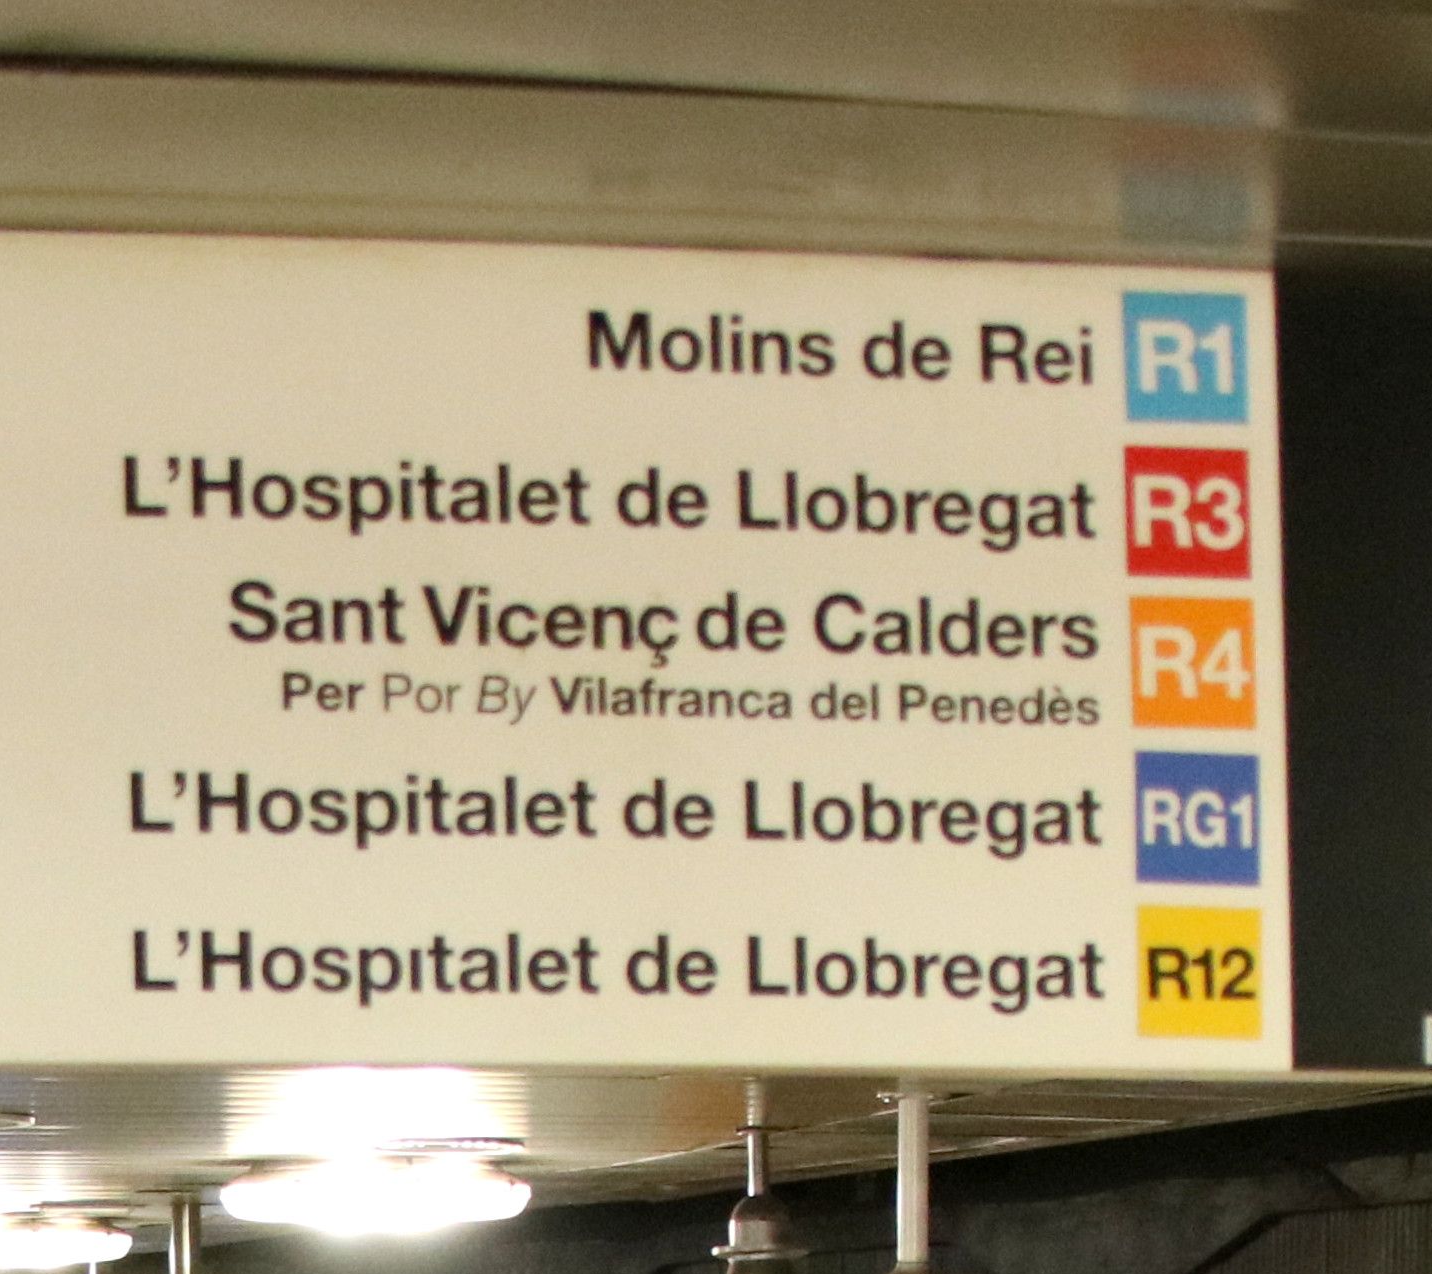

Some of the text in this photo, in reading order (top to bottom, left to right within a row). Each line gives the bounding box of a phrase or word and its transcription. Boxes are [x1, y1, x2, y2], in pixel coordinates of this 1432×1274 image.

[588, 311, 1093, 385] Molins de Rei
[1136, 319, 1236, 395] R1
[616, 466, 708, 530] de
[737, 470, 1097, 553] Llobregat
[1132, 473, 1246, 552] R3
[229, 580, 1100, 669] Sant Vicenç de Calders
[1137, 624, 1251, 700] R4
[281, 672, 1101, 727] Per Por By Vilafranca del Penedès
[623, 778, 715, 841] de
[744, 780, 1103, 861] Llobregat
[1143, 789, 1255, 849] RG1
[626, 934, 718, 997] de
[747, 935, 1105, 1016] Llobregat
[1147, 946, 1256, 1001] R12
